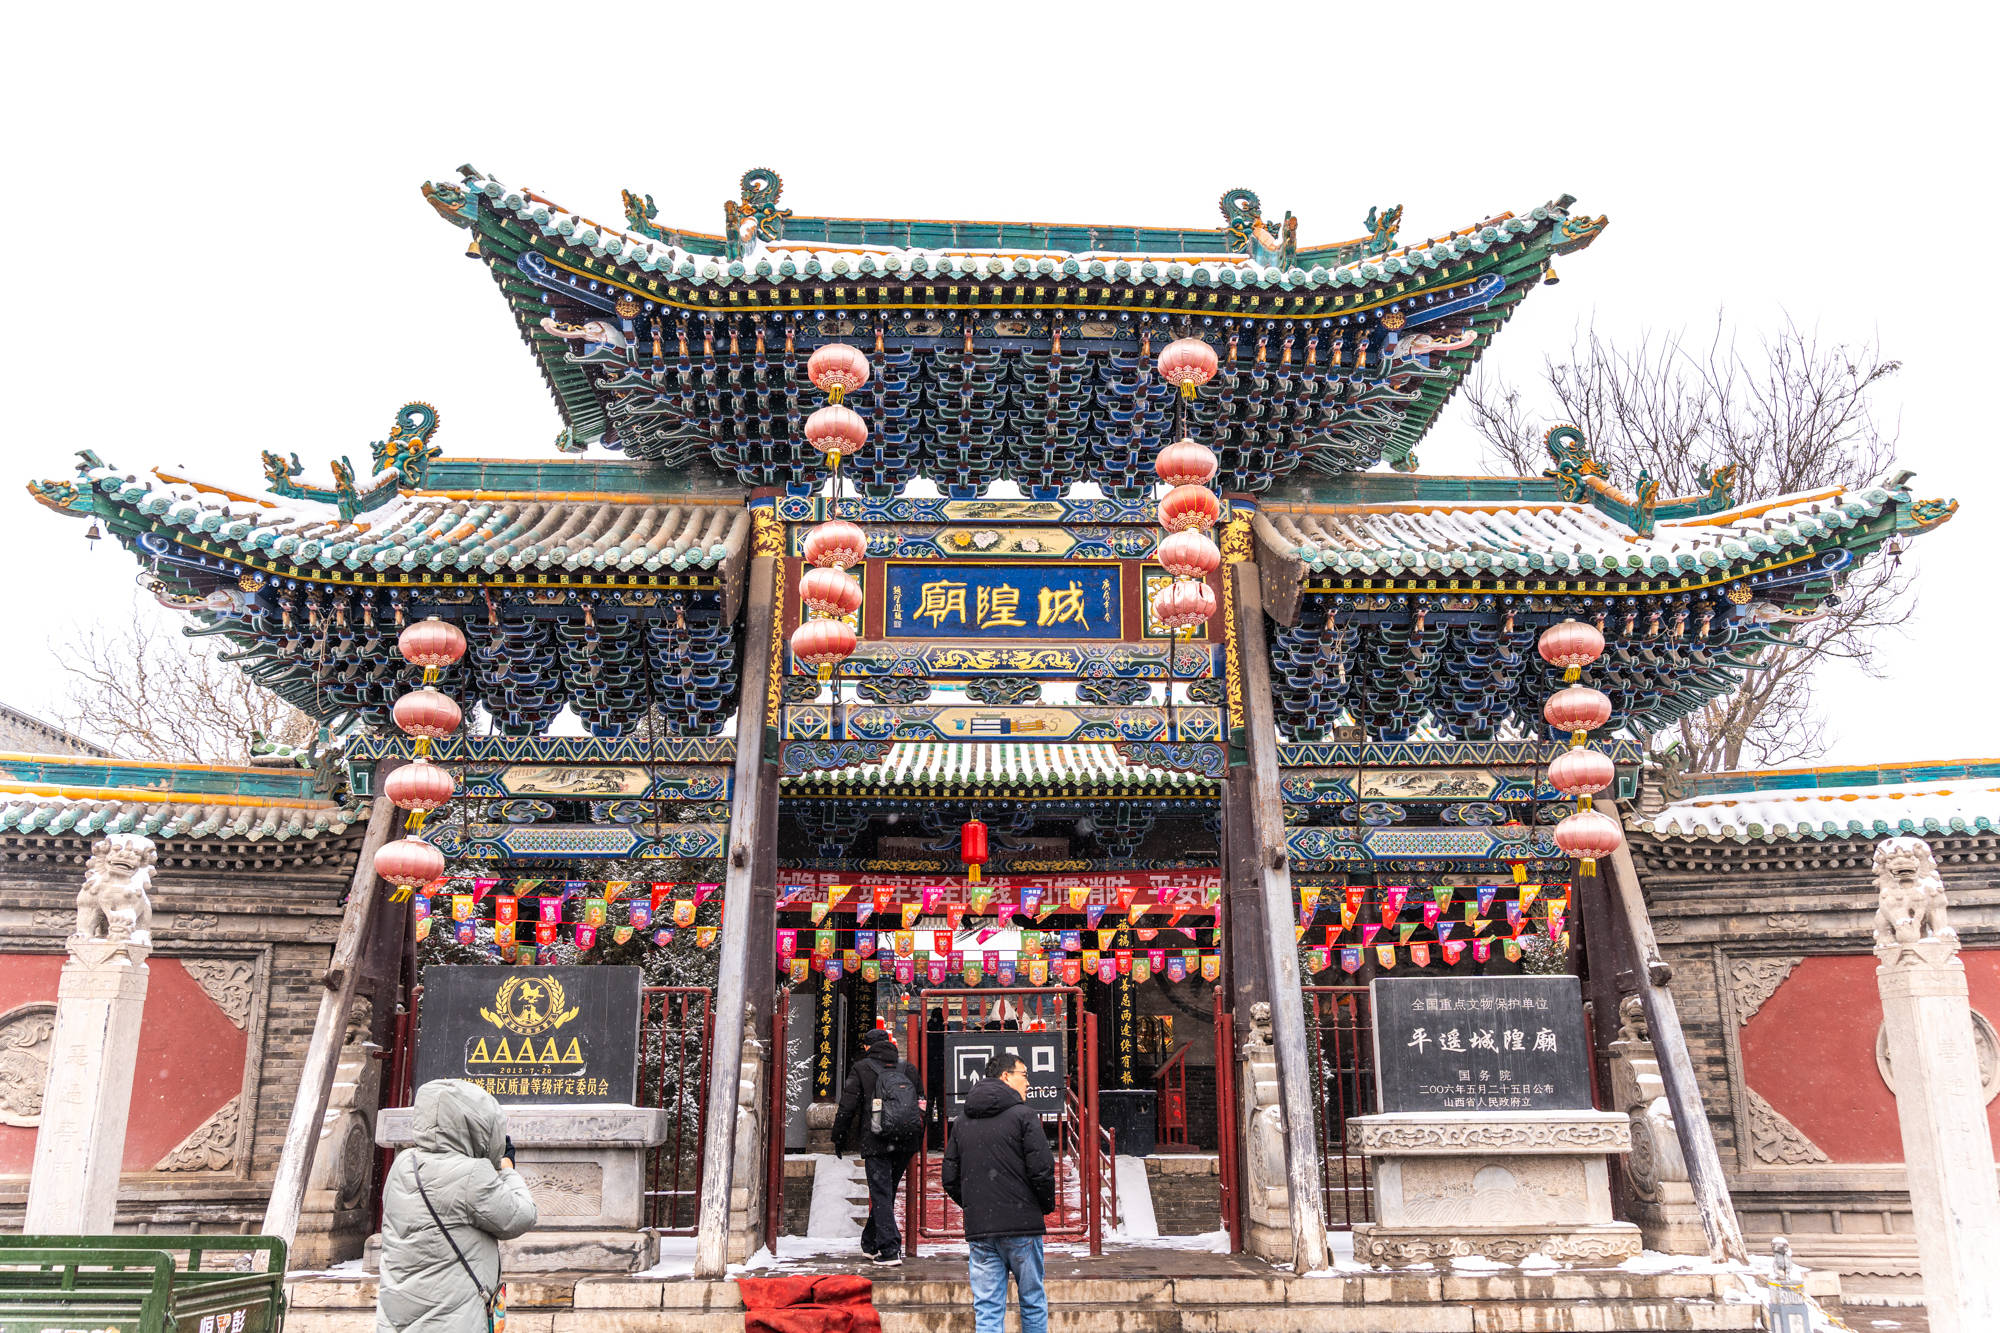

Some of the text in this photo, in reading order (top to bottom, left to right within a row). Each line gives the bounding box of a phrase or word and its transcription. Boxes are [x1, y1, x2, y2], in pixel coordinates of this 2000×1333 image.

[913, 579, 1090, 631] 城隍廟
[1411, 998, 1549, 1011] 全国重点文物保护单位
[468, 1037, 584, 1064] AAAAA
[444, 1077, 608, 1097] 游景区质量等级评定委员会
[1443, 1096, 1532, 1108] 山西省人民政府立
